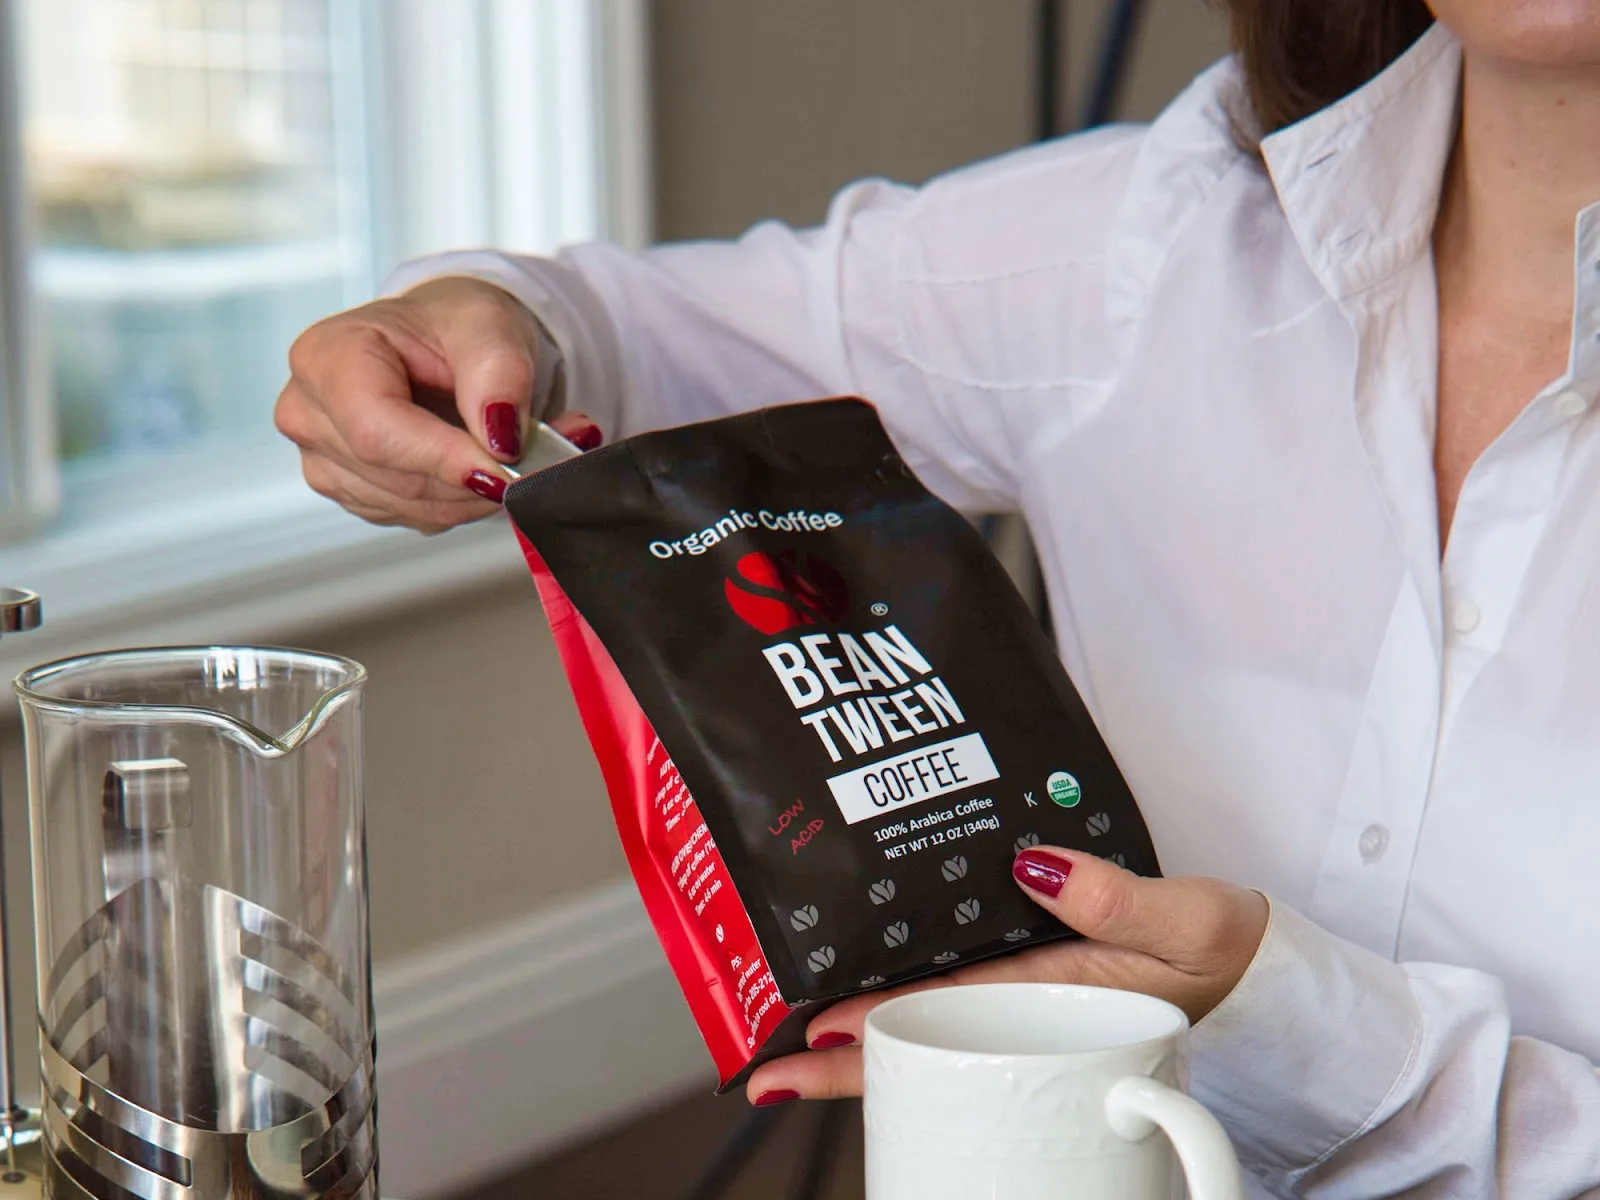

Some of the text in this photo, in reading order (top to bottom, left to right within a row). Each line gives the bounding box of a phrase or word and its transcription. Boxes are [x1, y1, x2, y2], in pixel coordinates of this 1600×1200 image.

[649, 509, 844, 560] Organic Coffee
[761, 624, 933, 710] BEAN
[800, 676, 966, 764] TWEEN
[863, 747, 969, 808] COFFEE
[1051, 778, 1073, 790] USDA
[1053, 788, 1079, 801] ORGANIC
[767, 798, 805, 837] LOW
[1023, 791, 1039, 808] K
[790, 818, 825, 857] ACID
[873, 797, 994, 843] 100% Arabica Coffee
[884, 814, 1001, 861] NET WT 12 OZ (340g)
[744, 957, 761, 980] water
[758, 996, 771, 1017] cool
